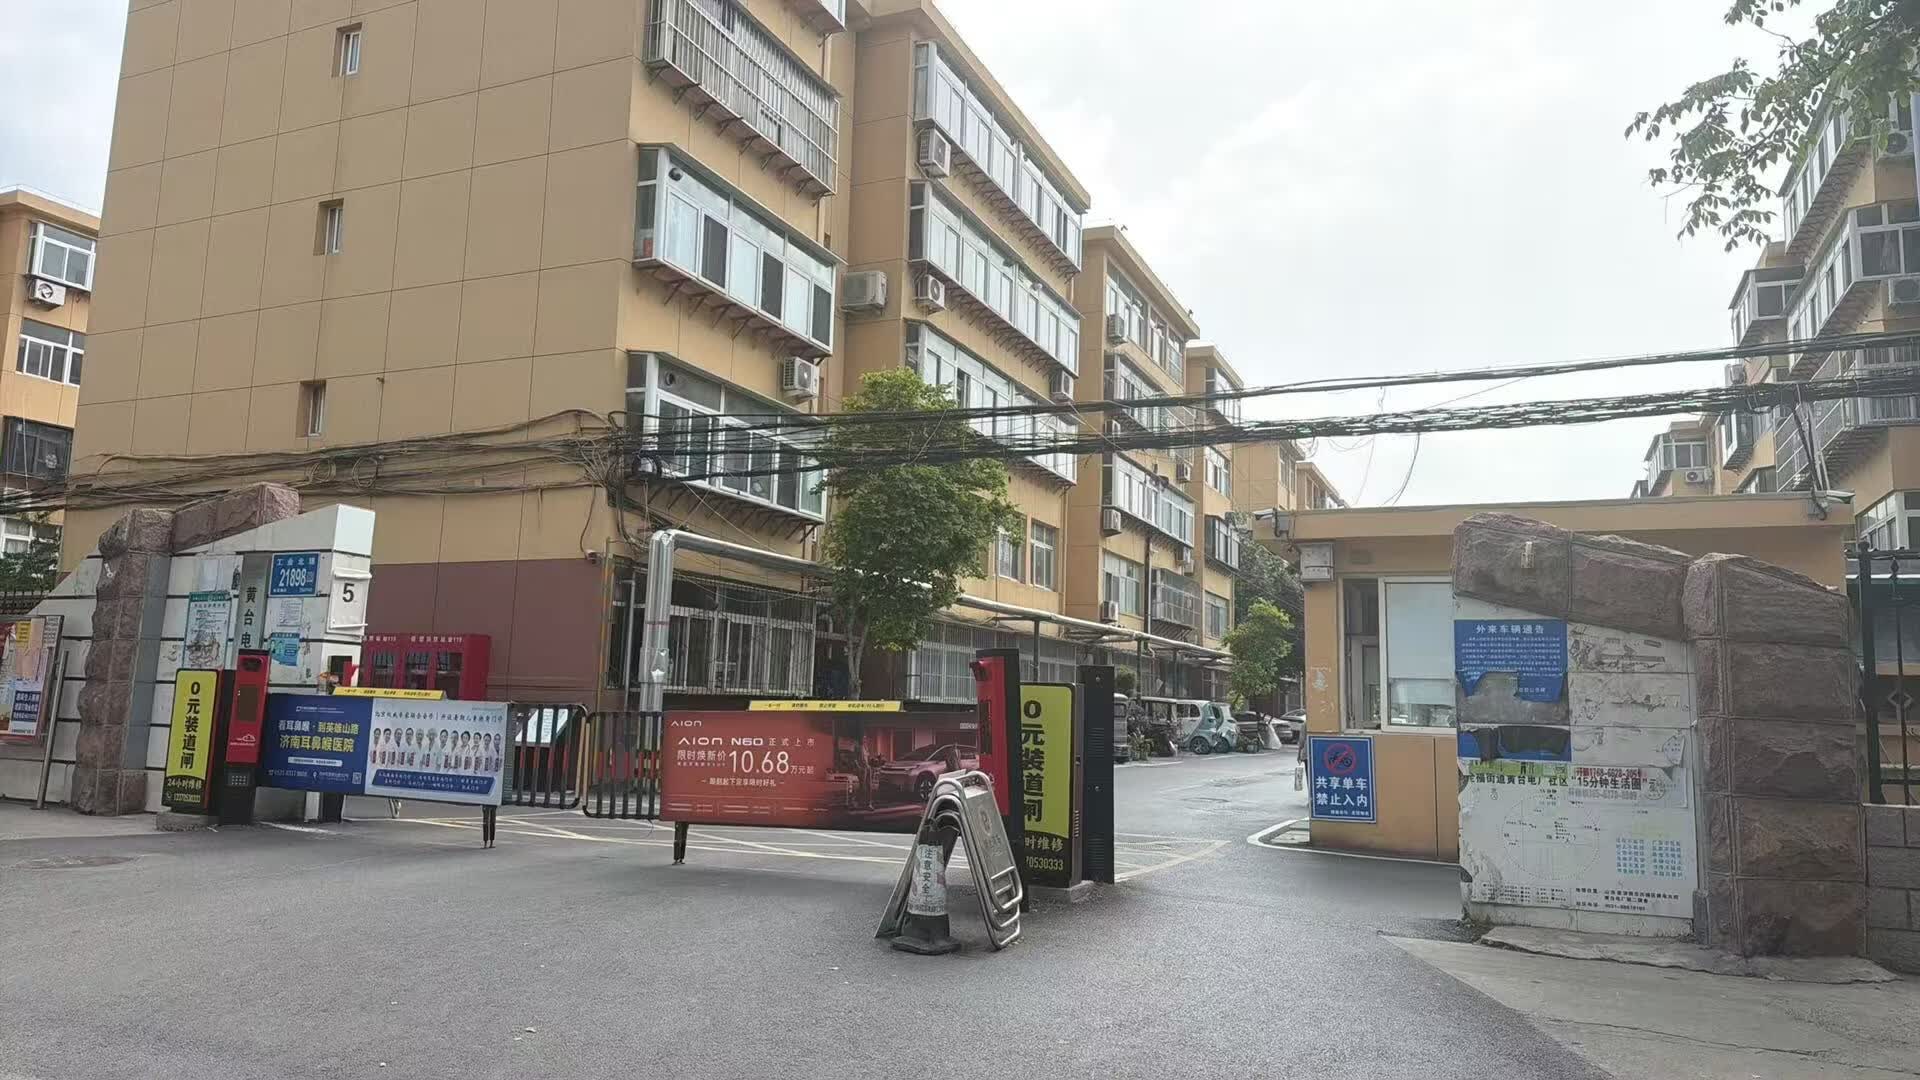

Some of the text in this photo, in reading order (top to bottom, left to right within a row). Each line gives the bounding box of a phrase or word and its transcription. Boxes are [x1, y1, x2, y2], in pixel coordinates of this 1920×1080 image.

[279, 568, 306, 587] 21898
[342, 582, 355, 603] 5
[1475, 624, 1545, 635] 外来车辆通告
[180, 681, 201, 770] 0元装道闸
[280, 734, 355, 753] 济南耳鼻喉医院
[678, 737, 815, 747] AION N60 正式上市
[677, 750, 727, 761] 限时焕新价
[728, 750, 789, 774] 10.68
[790, 765, 815, 775] 万元起
[1316, 776, 1367, 790] 共享单车
[1316, 793, 1367, 807] 禁止入内
